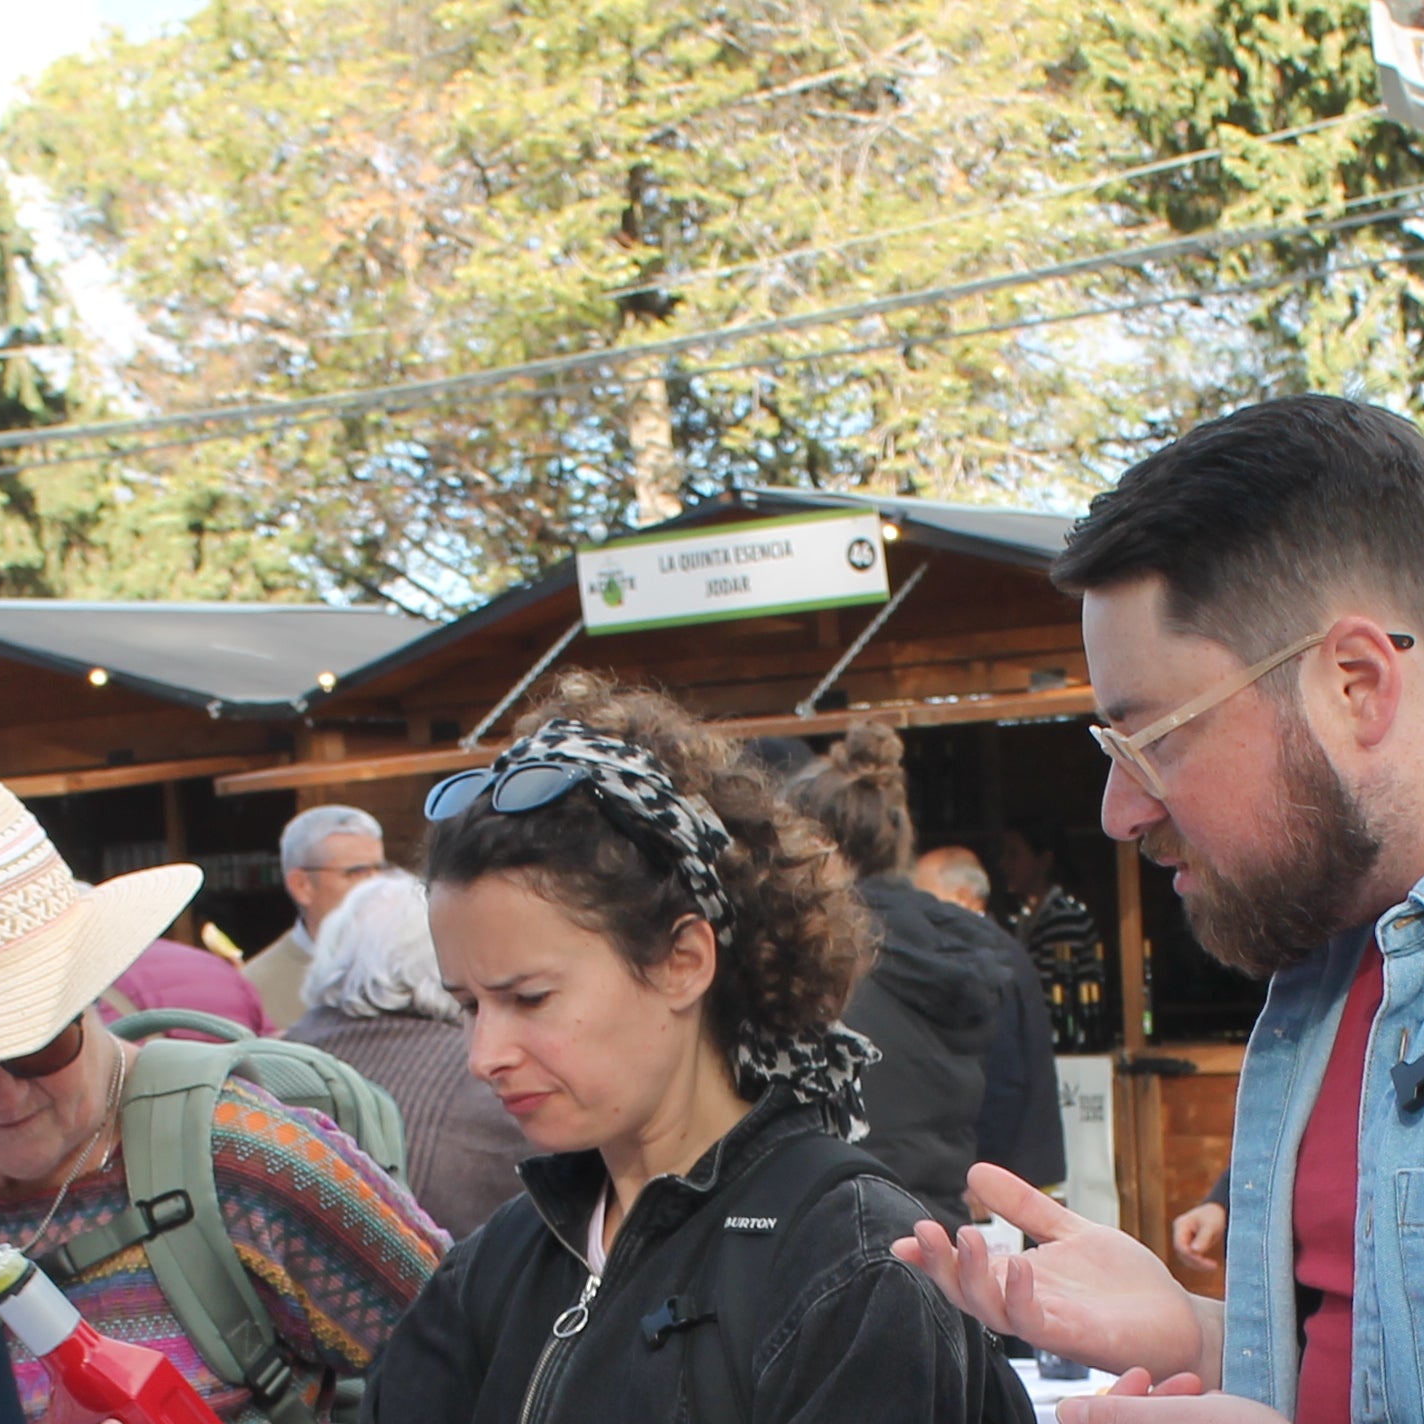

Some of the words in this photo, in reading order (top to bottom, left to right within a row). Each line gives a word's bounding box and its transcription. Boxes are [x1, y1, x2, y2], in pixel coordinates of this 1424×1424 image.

[658, 553, 677, 574] LA
[679, 547, 732, 573] QUINTA
[734, 539, 794, 565] ESENCIA
[723, 1216, 778, 1230] BURTON
